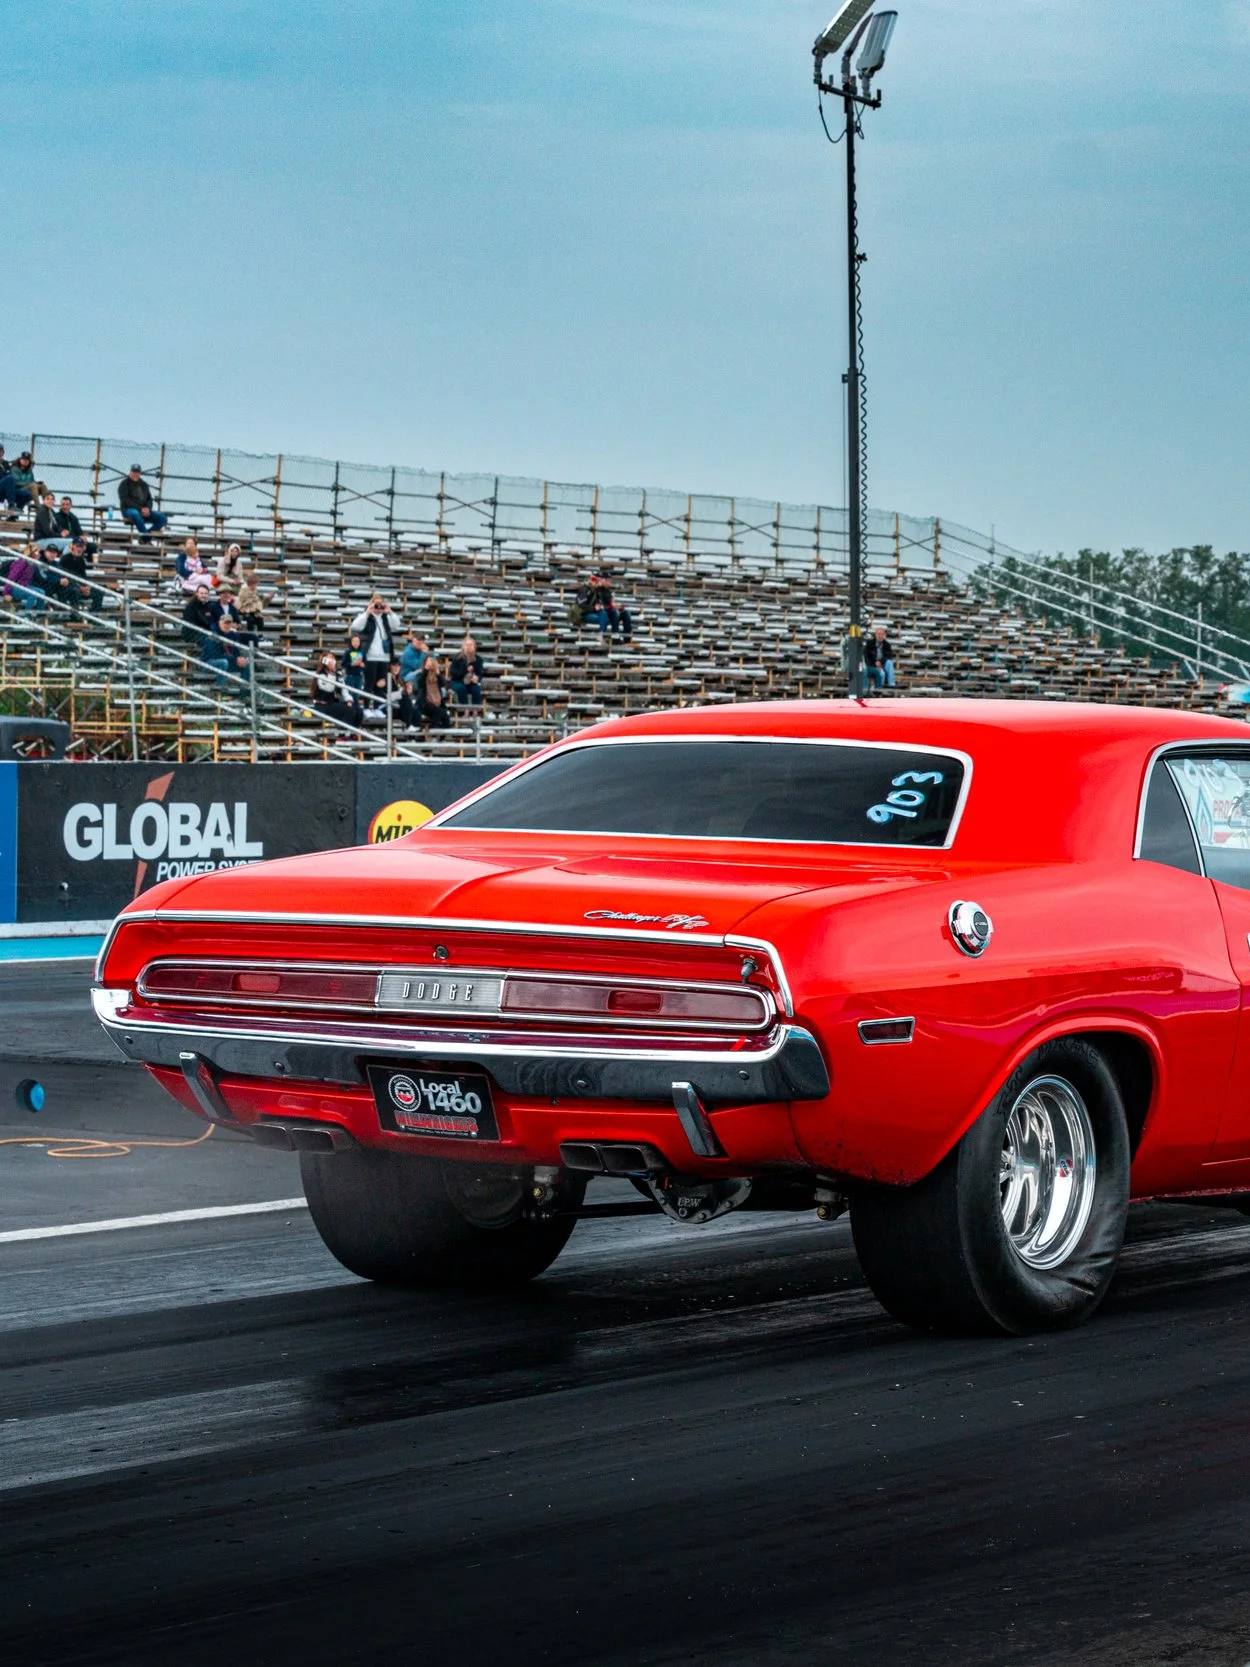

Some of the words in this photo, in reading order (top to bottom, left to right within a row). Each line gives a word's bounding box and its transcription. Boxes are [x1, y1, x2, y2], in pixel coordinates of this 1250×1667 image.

[866, 770, 944, 824] 903
[63, 802, 263, 861] GLOBAL
[402, 982, 473, 1001] DODGE
[419, 1078, 462, 1096] Local
[423, 1091, 483, 1114] 1460
